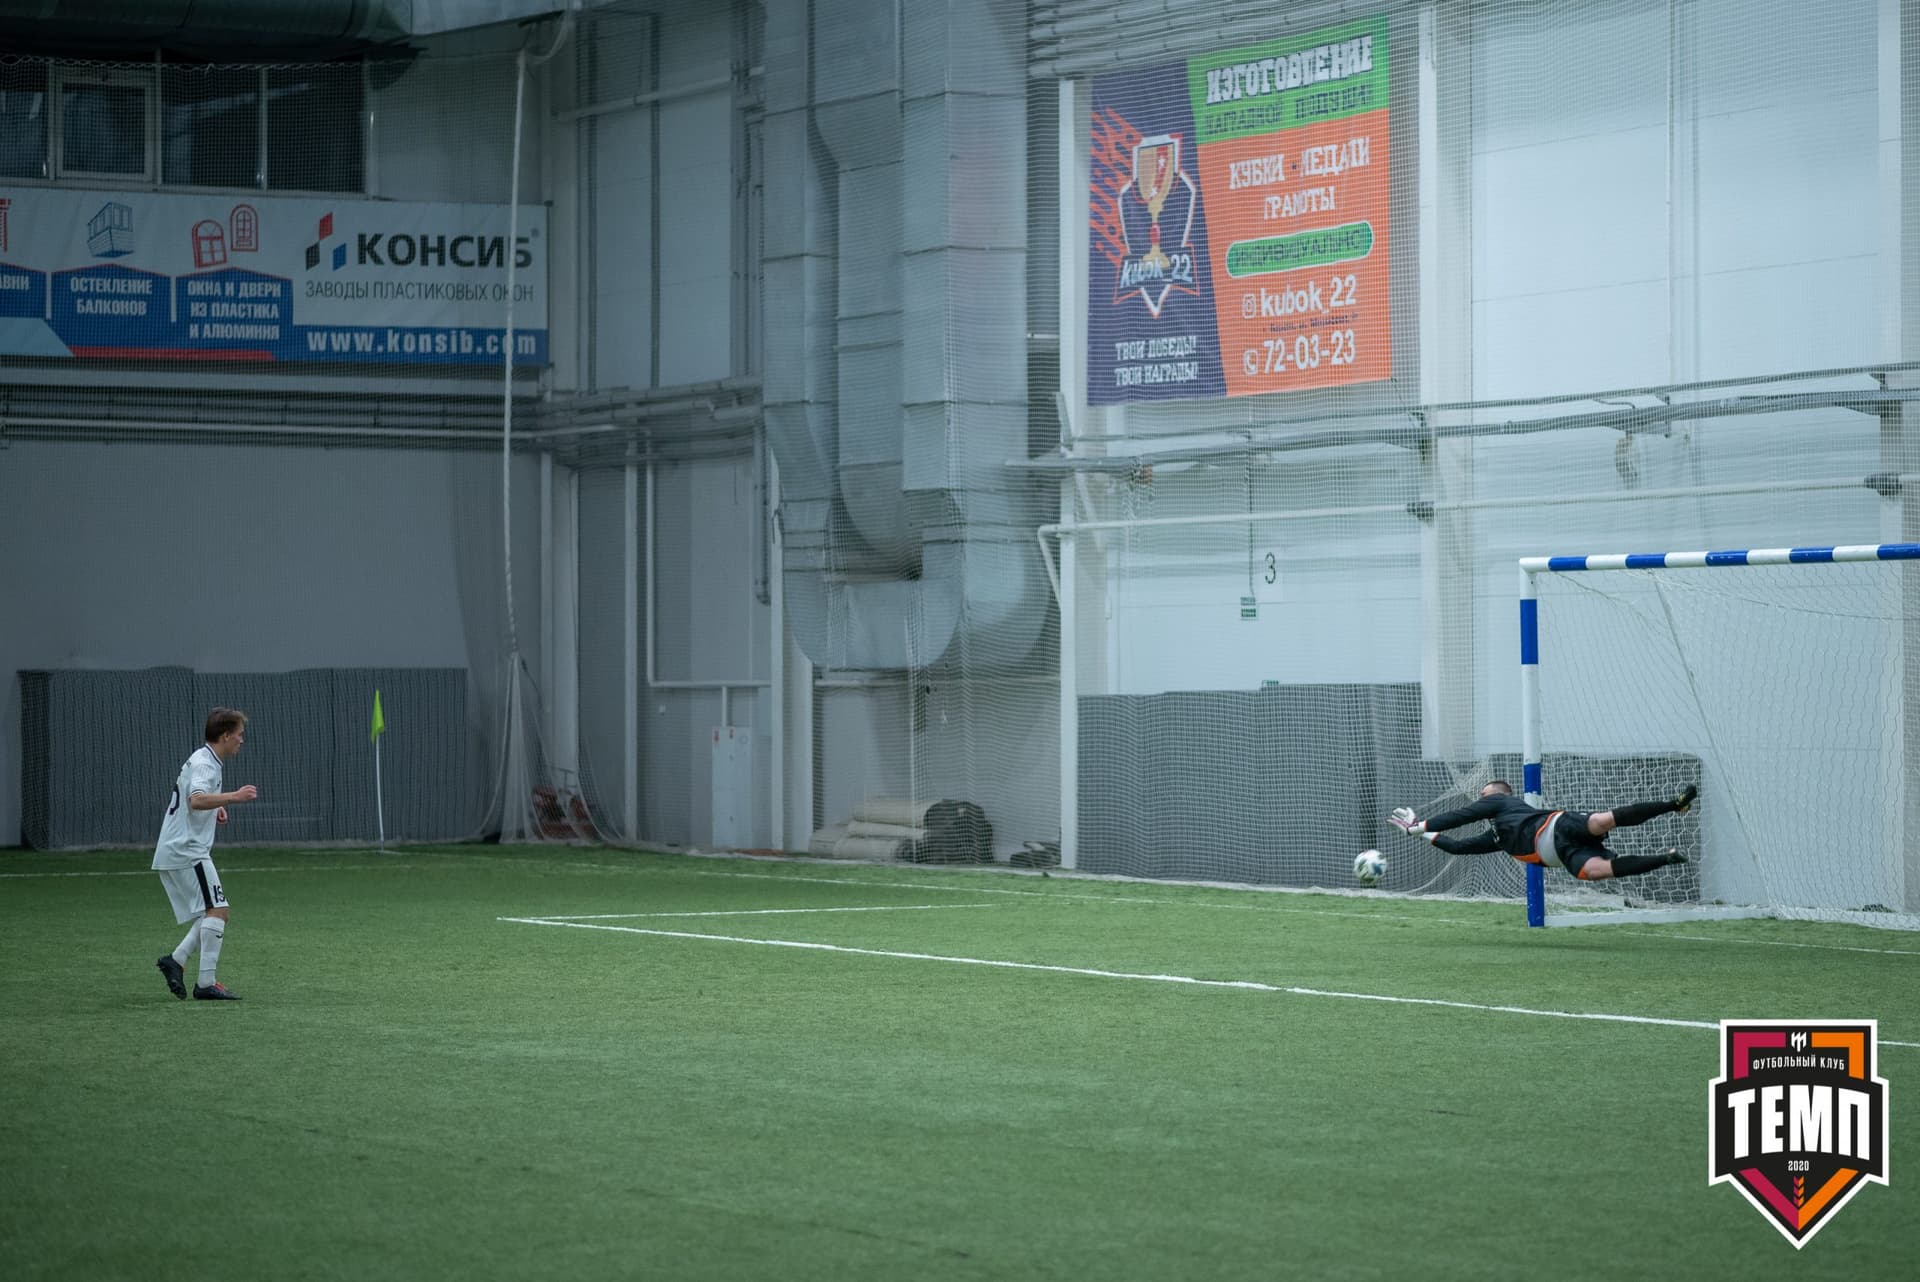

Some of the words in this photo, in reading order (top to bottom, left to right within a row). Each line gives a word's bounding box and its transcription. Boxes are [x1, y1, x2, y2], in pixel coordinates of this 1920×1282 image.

[1229, 154, 1285, 190] КУБКИ
[1264, 186, 1336, 220] ГРАМОТЫ
[357, 233, 533, 269] КОНСИБ
[70, 277, 153, 295] ОСТЕКЛЕНИЕ
[187, 281, 221, 297] ОКНА
[225, 282, 235, 297] И
[239, 282, 281, 299] ДВЕРИ
[306, 280, 368, 300] ЗАВОДЫ
[373, 281, 488, 300] ПЛАСТИКОВЫХ
[77, 299, 147, 317] БАЛКОНОВ
[190, 302, 207, 318] ИЗ
[211, 303, 279, 320] ПЛАСТИКА
[189, 324, 199, 339] И
[203, 324, 280, 340] АЛЮМИНИЯ
[1263, 329, 1356, 375] 72-03-23
[1265, 552, 1276, 584] 3
